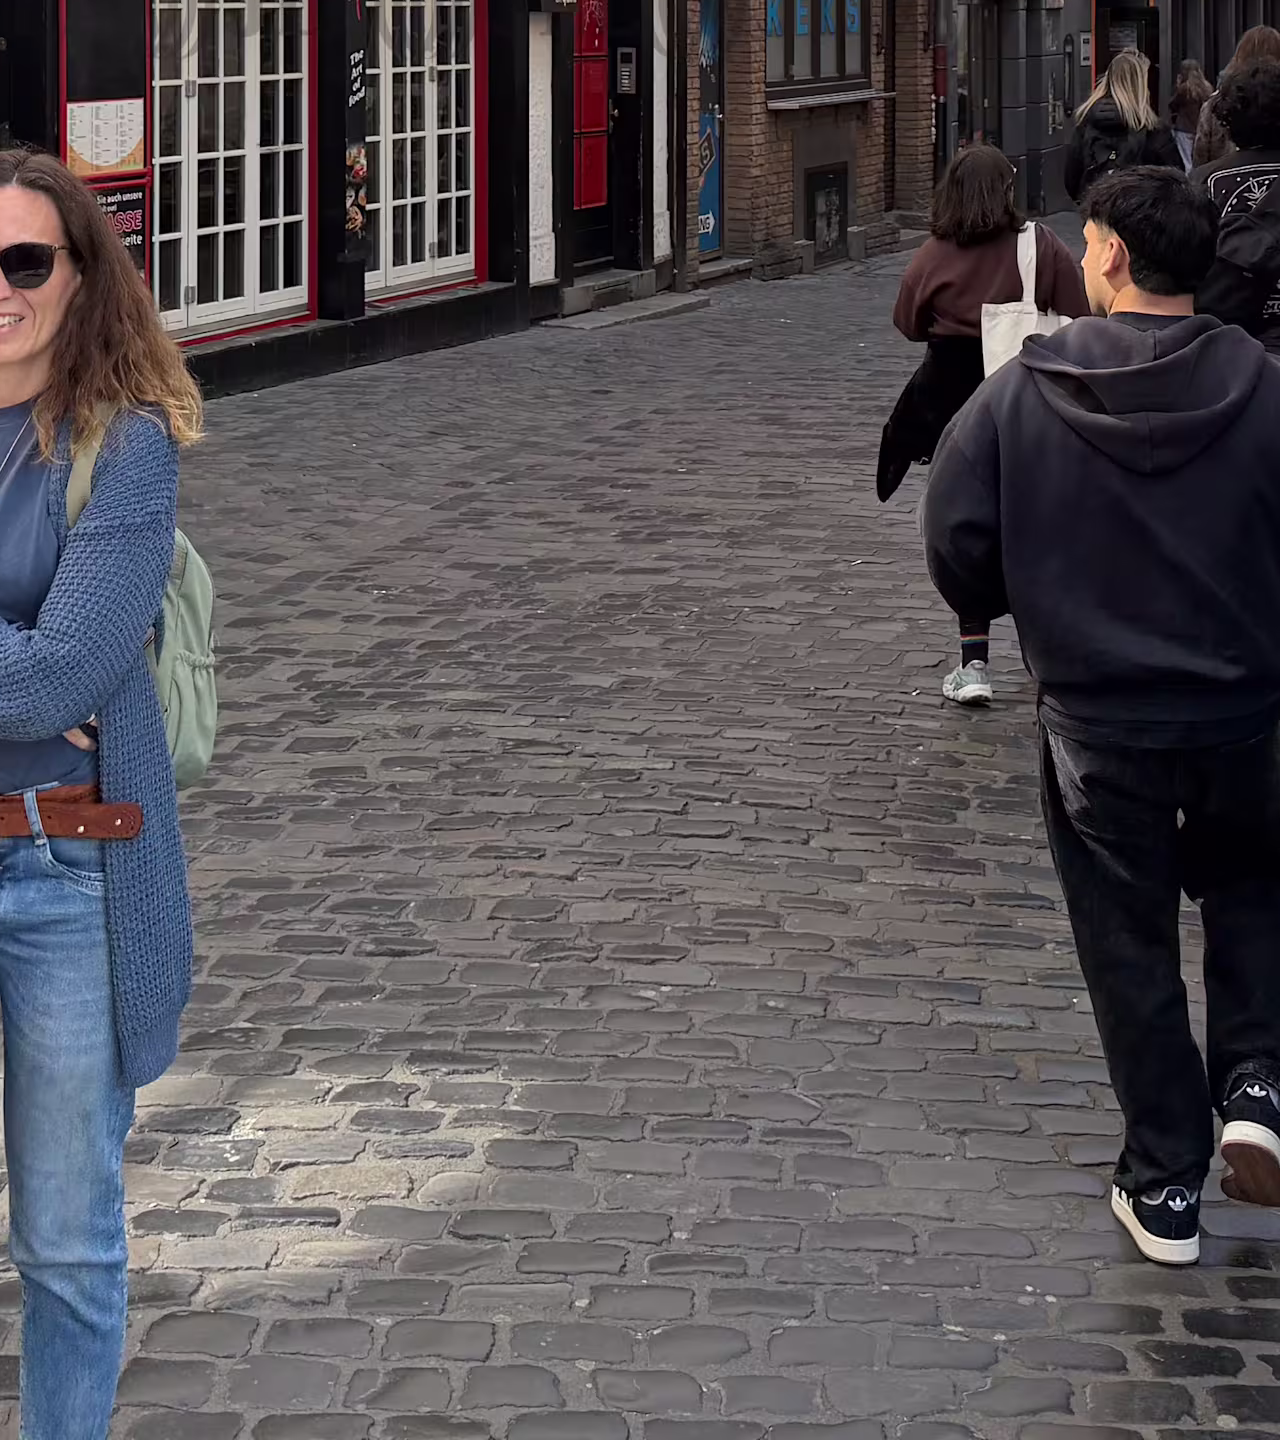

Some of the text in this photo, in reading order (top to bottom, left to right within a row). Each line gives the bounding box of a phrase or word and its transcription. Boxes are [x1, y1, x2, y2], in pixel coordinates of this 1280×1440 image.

[349, 49, 365, 66] The
[350, 63, 363, 81] Art
[107, 192, 122, 203] auch
[123, 191, 143, 202] unsere
